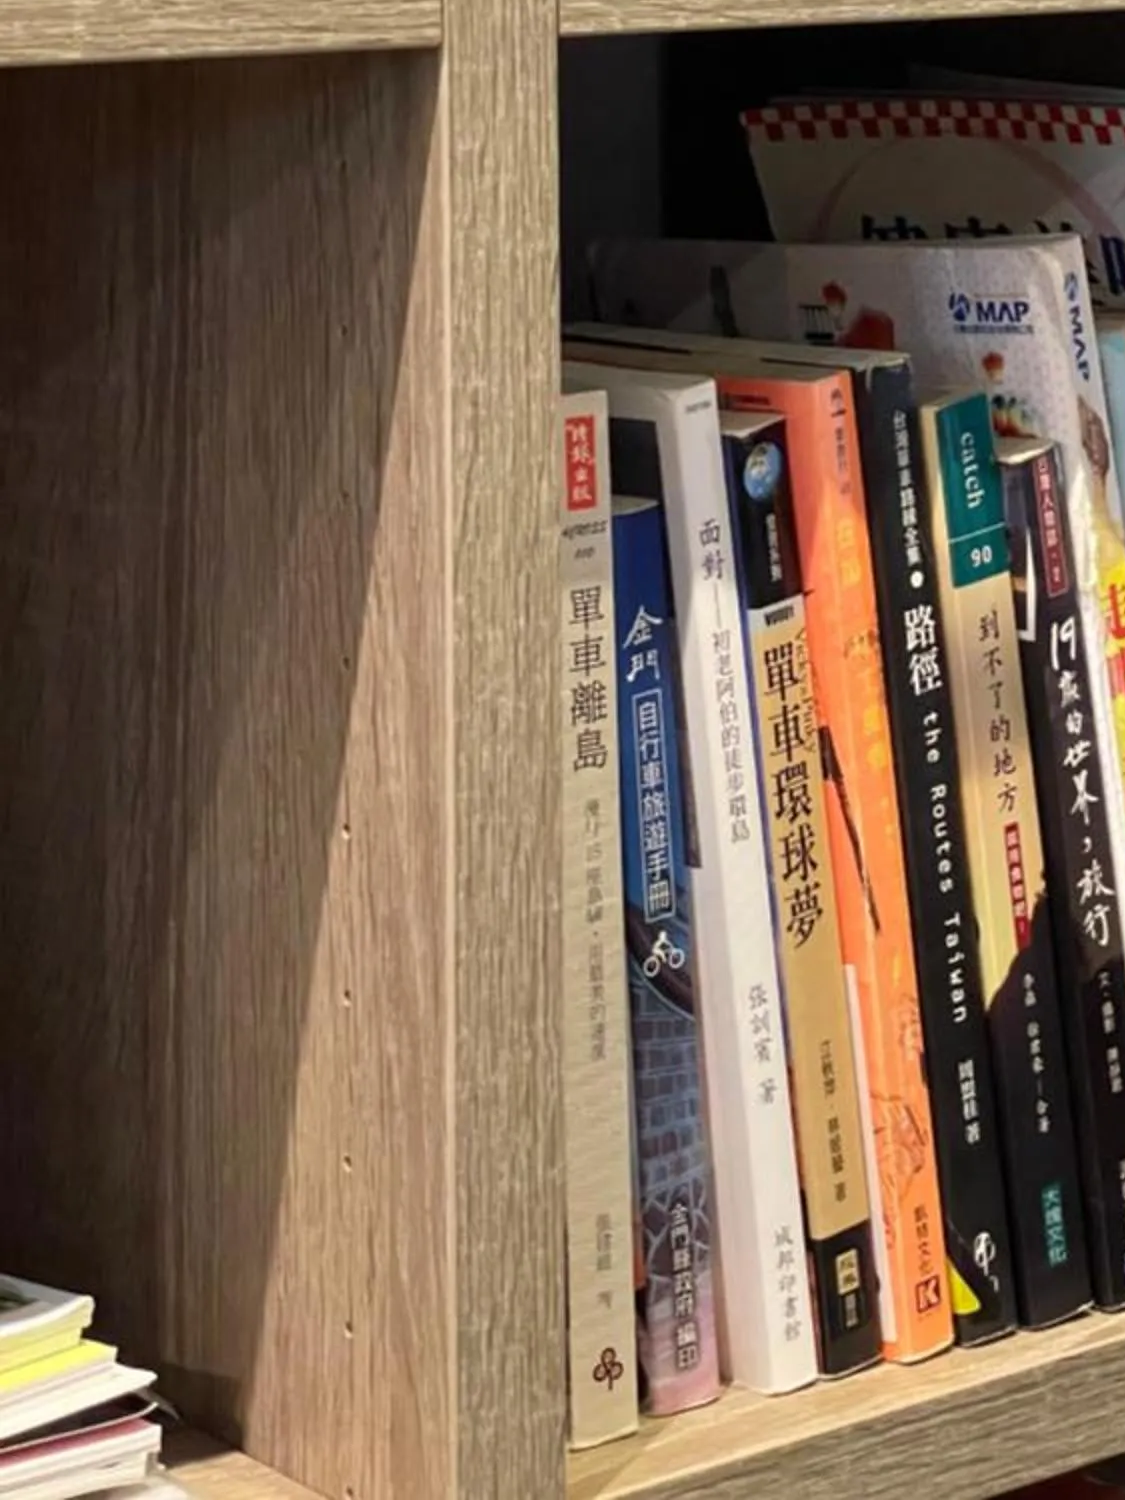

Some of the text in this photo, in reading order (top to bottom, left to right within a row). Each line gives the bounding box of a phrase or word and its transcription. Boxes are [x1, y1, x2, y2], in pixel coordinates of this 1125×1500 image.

[975, 299, 1031, 324] MAP
[1068, 307, 1090, 383] MAP
[960, 432, 986, 510] catch
[970, 543, 993, 569] 90
[568, 585, 608, 773] 單車離島
[622, 605, 664, 683] 金門
[902, 604, 944, 698] 路徑
[978, 613, 1019, 814] 到不了的地方
[762, 640, 825, 950] 單車環球夢
[922, 711, 968, 1025] the Routes Taiwan
